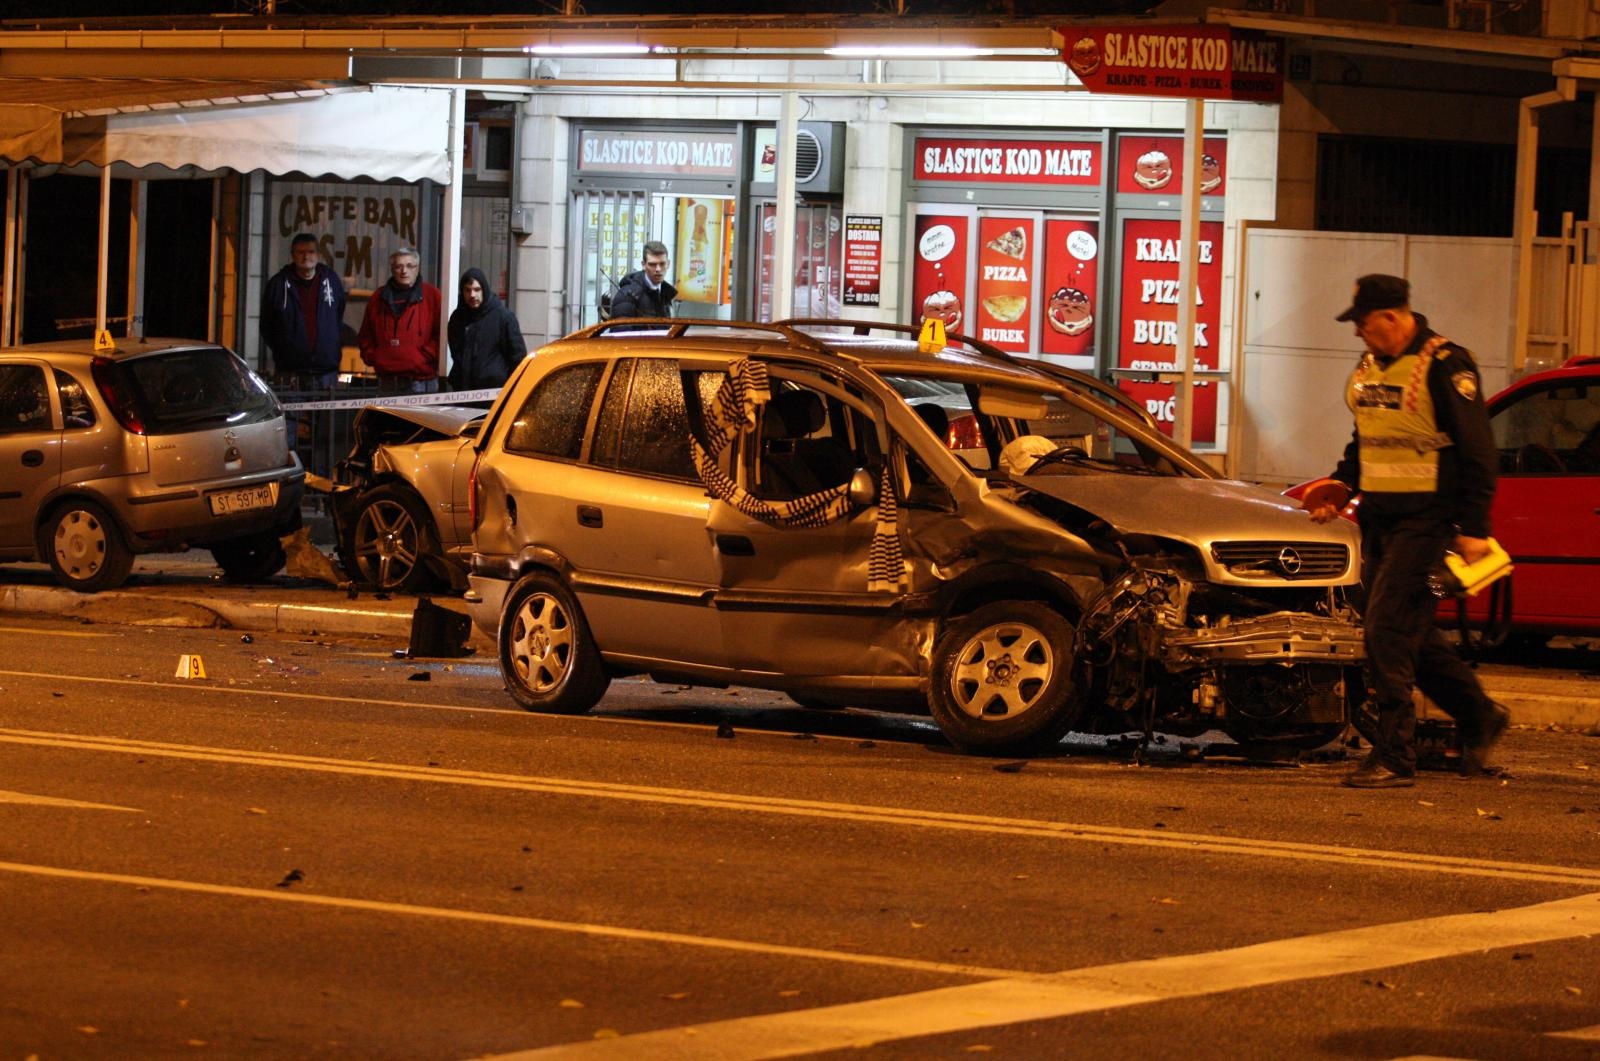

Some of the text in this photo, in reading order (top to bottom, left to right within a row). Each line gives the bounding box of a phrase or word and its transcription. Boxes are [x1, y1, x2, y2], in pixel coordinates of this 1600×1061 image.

[1104, 33, 1277, 74] SLASTICE KOD MATE
[1106, 74, 1147, 87] KRAFNE
[1154, 76, 1182, 88] PIZZA
[584, 138, 733, 168] SLASTICE KOD MATE
[924, 147, 1092, 176] SLASTICE KOD MATE
[278, 195, 416, 246] CAFFE BAR
[847, 229, 880, 242] DOSTAVA
[1136, 238, 1213, 264] KRAE
[983, 266, 1028, 282] PIZZA
[982, 328, 1025, 344] BUREK
[1133, 319, 1209, 347] BURK
[1145, 396, 1175, 422] PIĆ
[217, 494, 230, 511] ST
